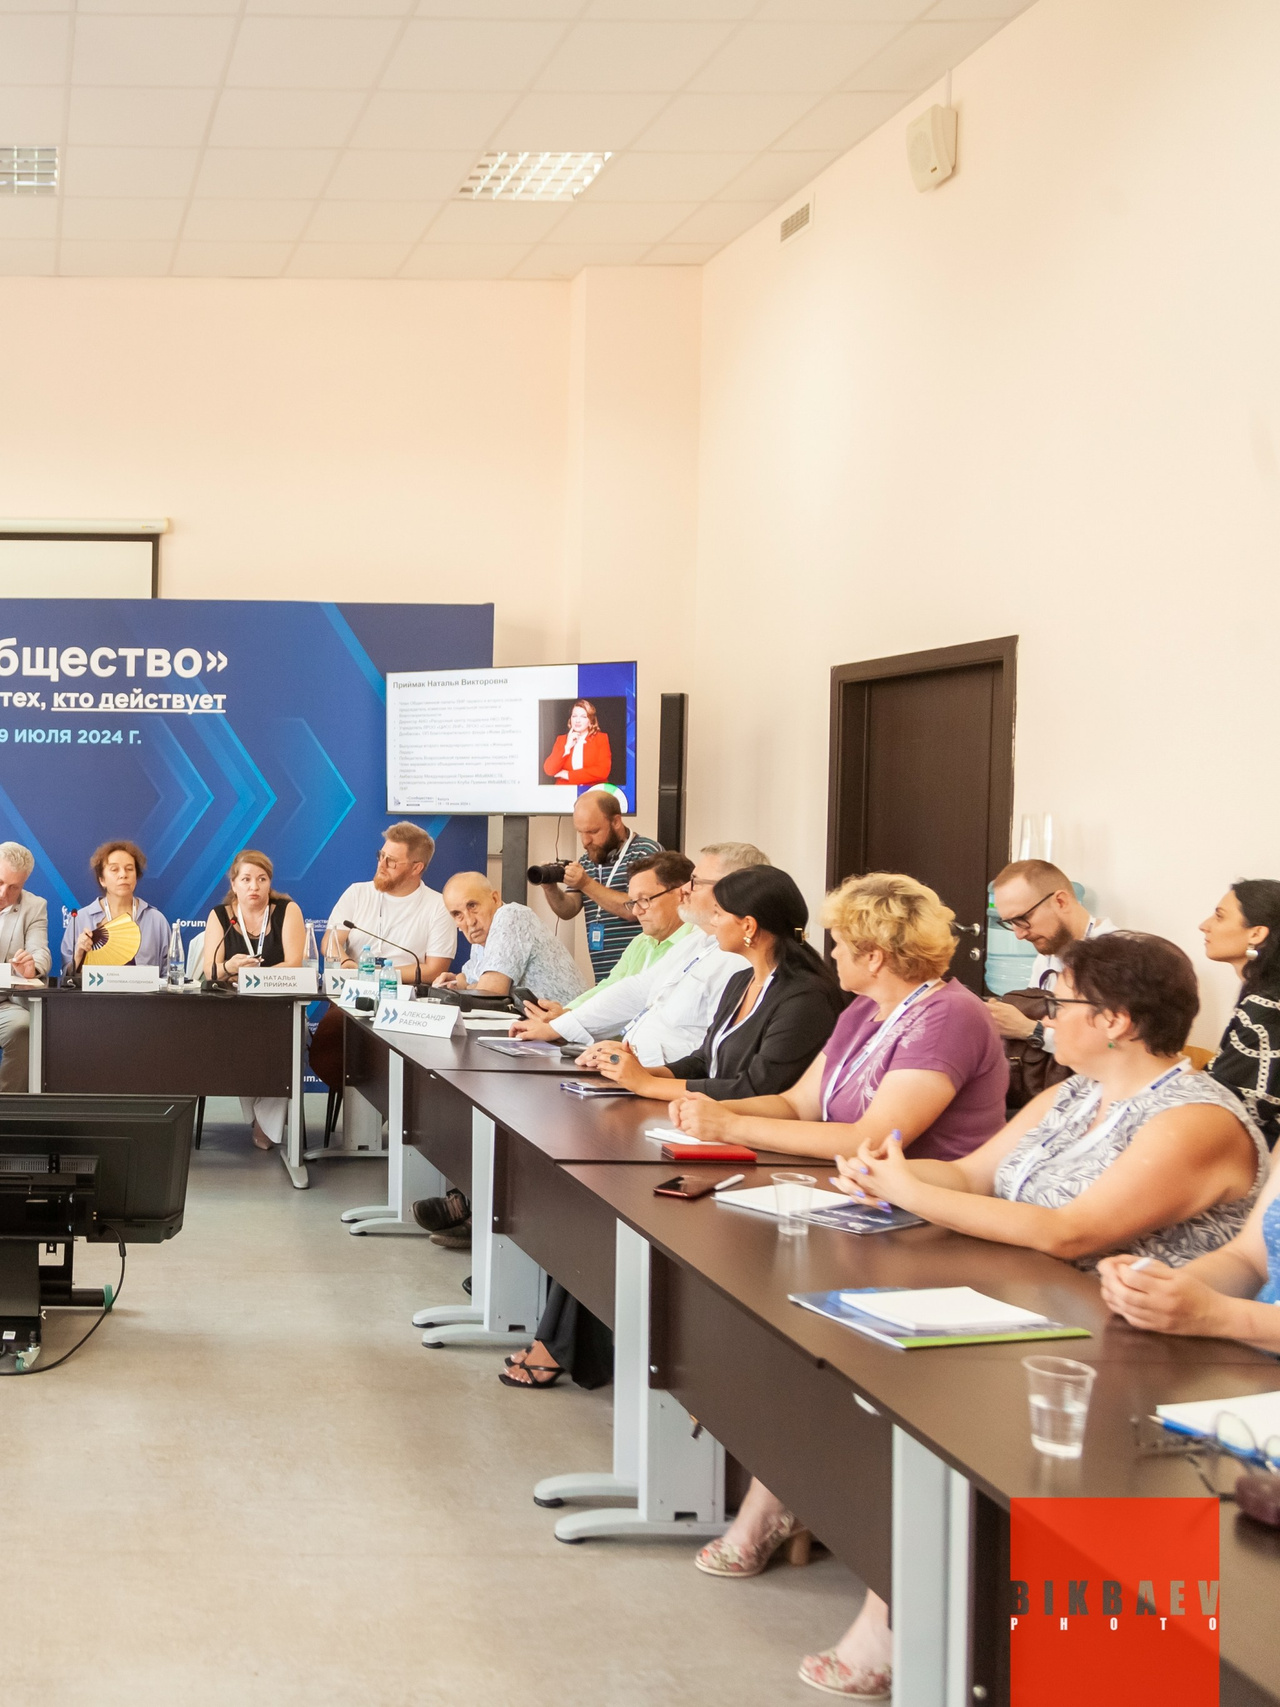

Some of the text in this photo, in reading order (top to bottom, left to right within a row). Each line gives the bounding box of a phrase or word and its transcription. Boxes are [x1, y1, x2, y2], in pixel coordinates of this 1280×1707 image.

[461, 678, 508, 686] Викторовна
[0, 691, 46, 710] тех,
[53, 692, 94, 709] кто
[99, 688, 226, 714] действует
[14, 728, 71, 743] ИЮЛЯ
[78, 729, 124, 744] 2024
[129, 730, 142, 744] Г.
[401, 1010, 446, 1022] АЛЕКСАНДР
[399, 1018, 428, 1028] РАЕНКО
